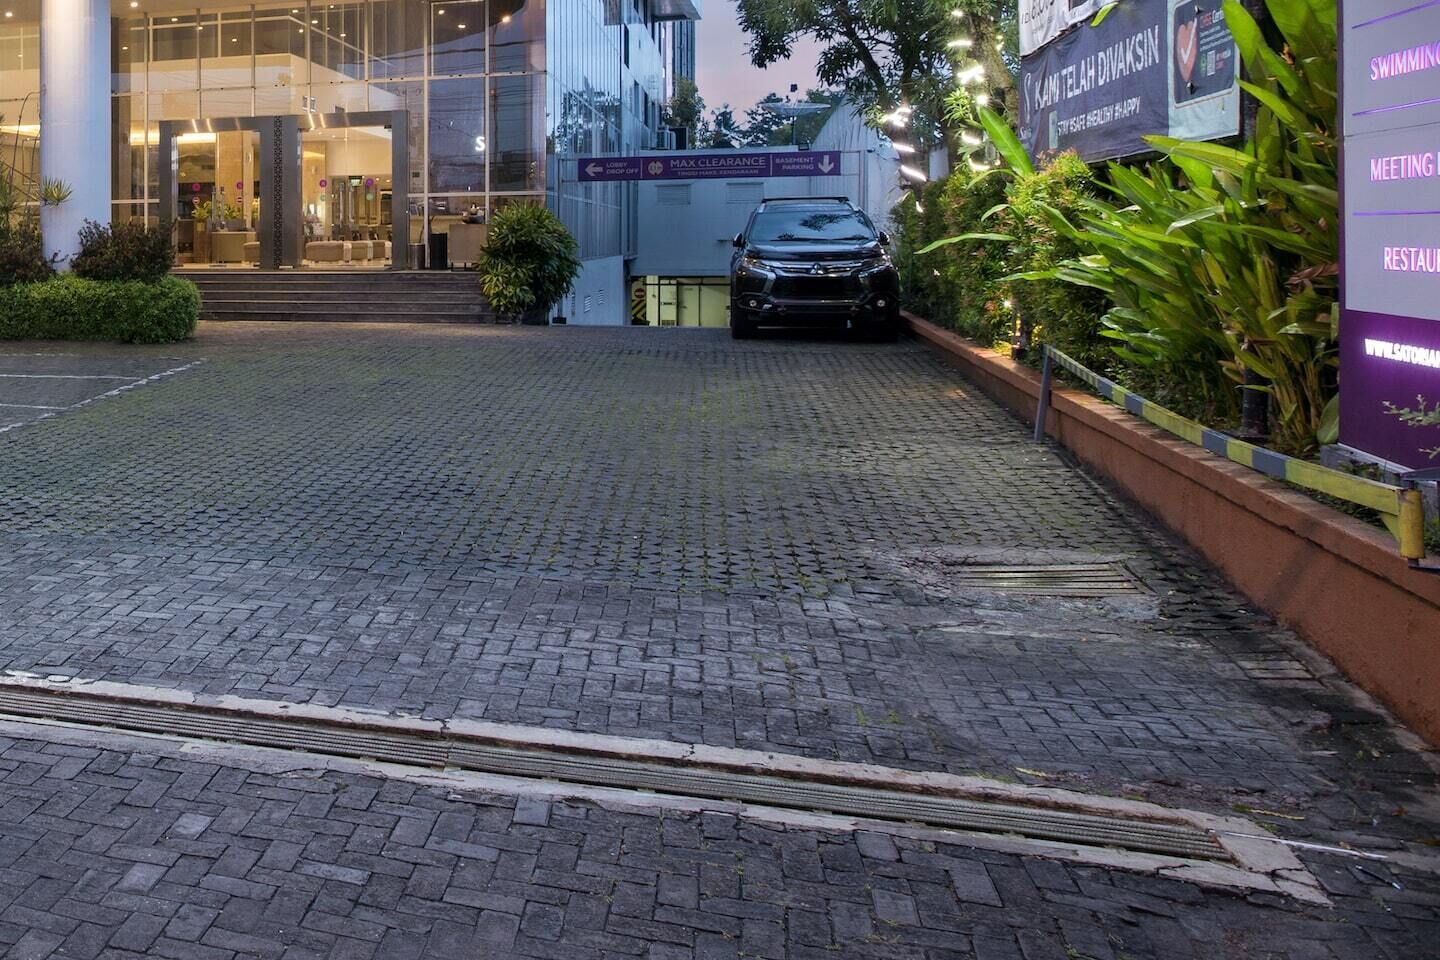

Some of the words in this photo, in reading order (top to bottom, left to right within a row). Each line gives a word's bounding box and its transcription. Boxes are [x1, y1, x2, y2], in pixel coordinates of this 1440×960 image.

[1035, 72, 1059, 110] KAMI
[1061, 55, 1095, 100] TELAH
[1098, 25, 1160, 86] DIVAKSIN
[1086, 104, 1115, 129] #HEALTHY
[1114, 95, 1141, 121] #HAPPY
[670, 159, 696, 168] MAX
[698, 156, 766, 167] CLEARANCE
[1370, 152, 1433, 182] MEETING
